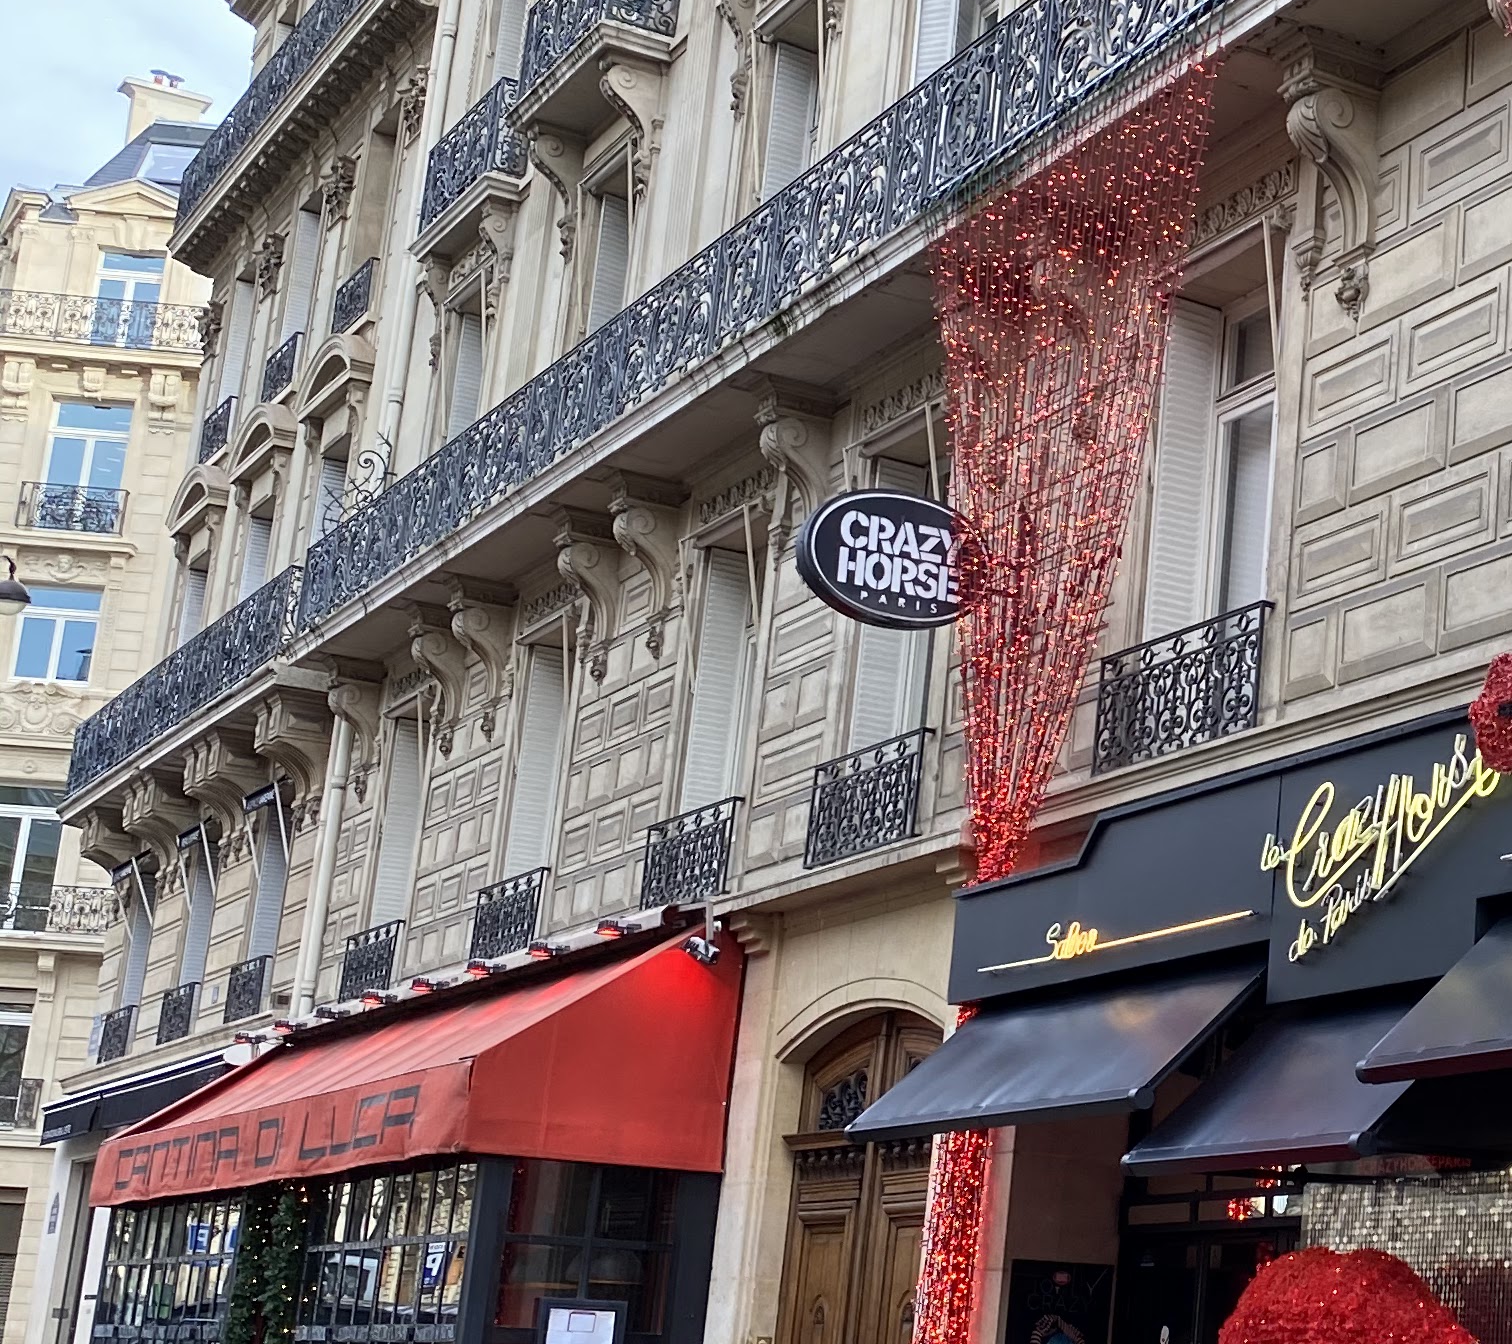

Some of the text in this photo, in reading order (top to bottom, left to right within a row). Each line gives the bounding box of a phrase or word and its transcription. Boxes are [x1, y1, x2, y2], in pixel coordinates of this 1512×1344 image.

[840, 510, 957, 566] CRAZY
[837, 546, 961, 603] HORSE
[860, 591, 938, 614] PARIS
[114, 1125, 240, 1191] CANTINA
[298, 1084, 421, 1162] LUCA
